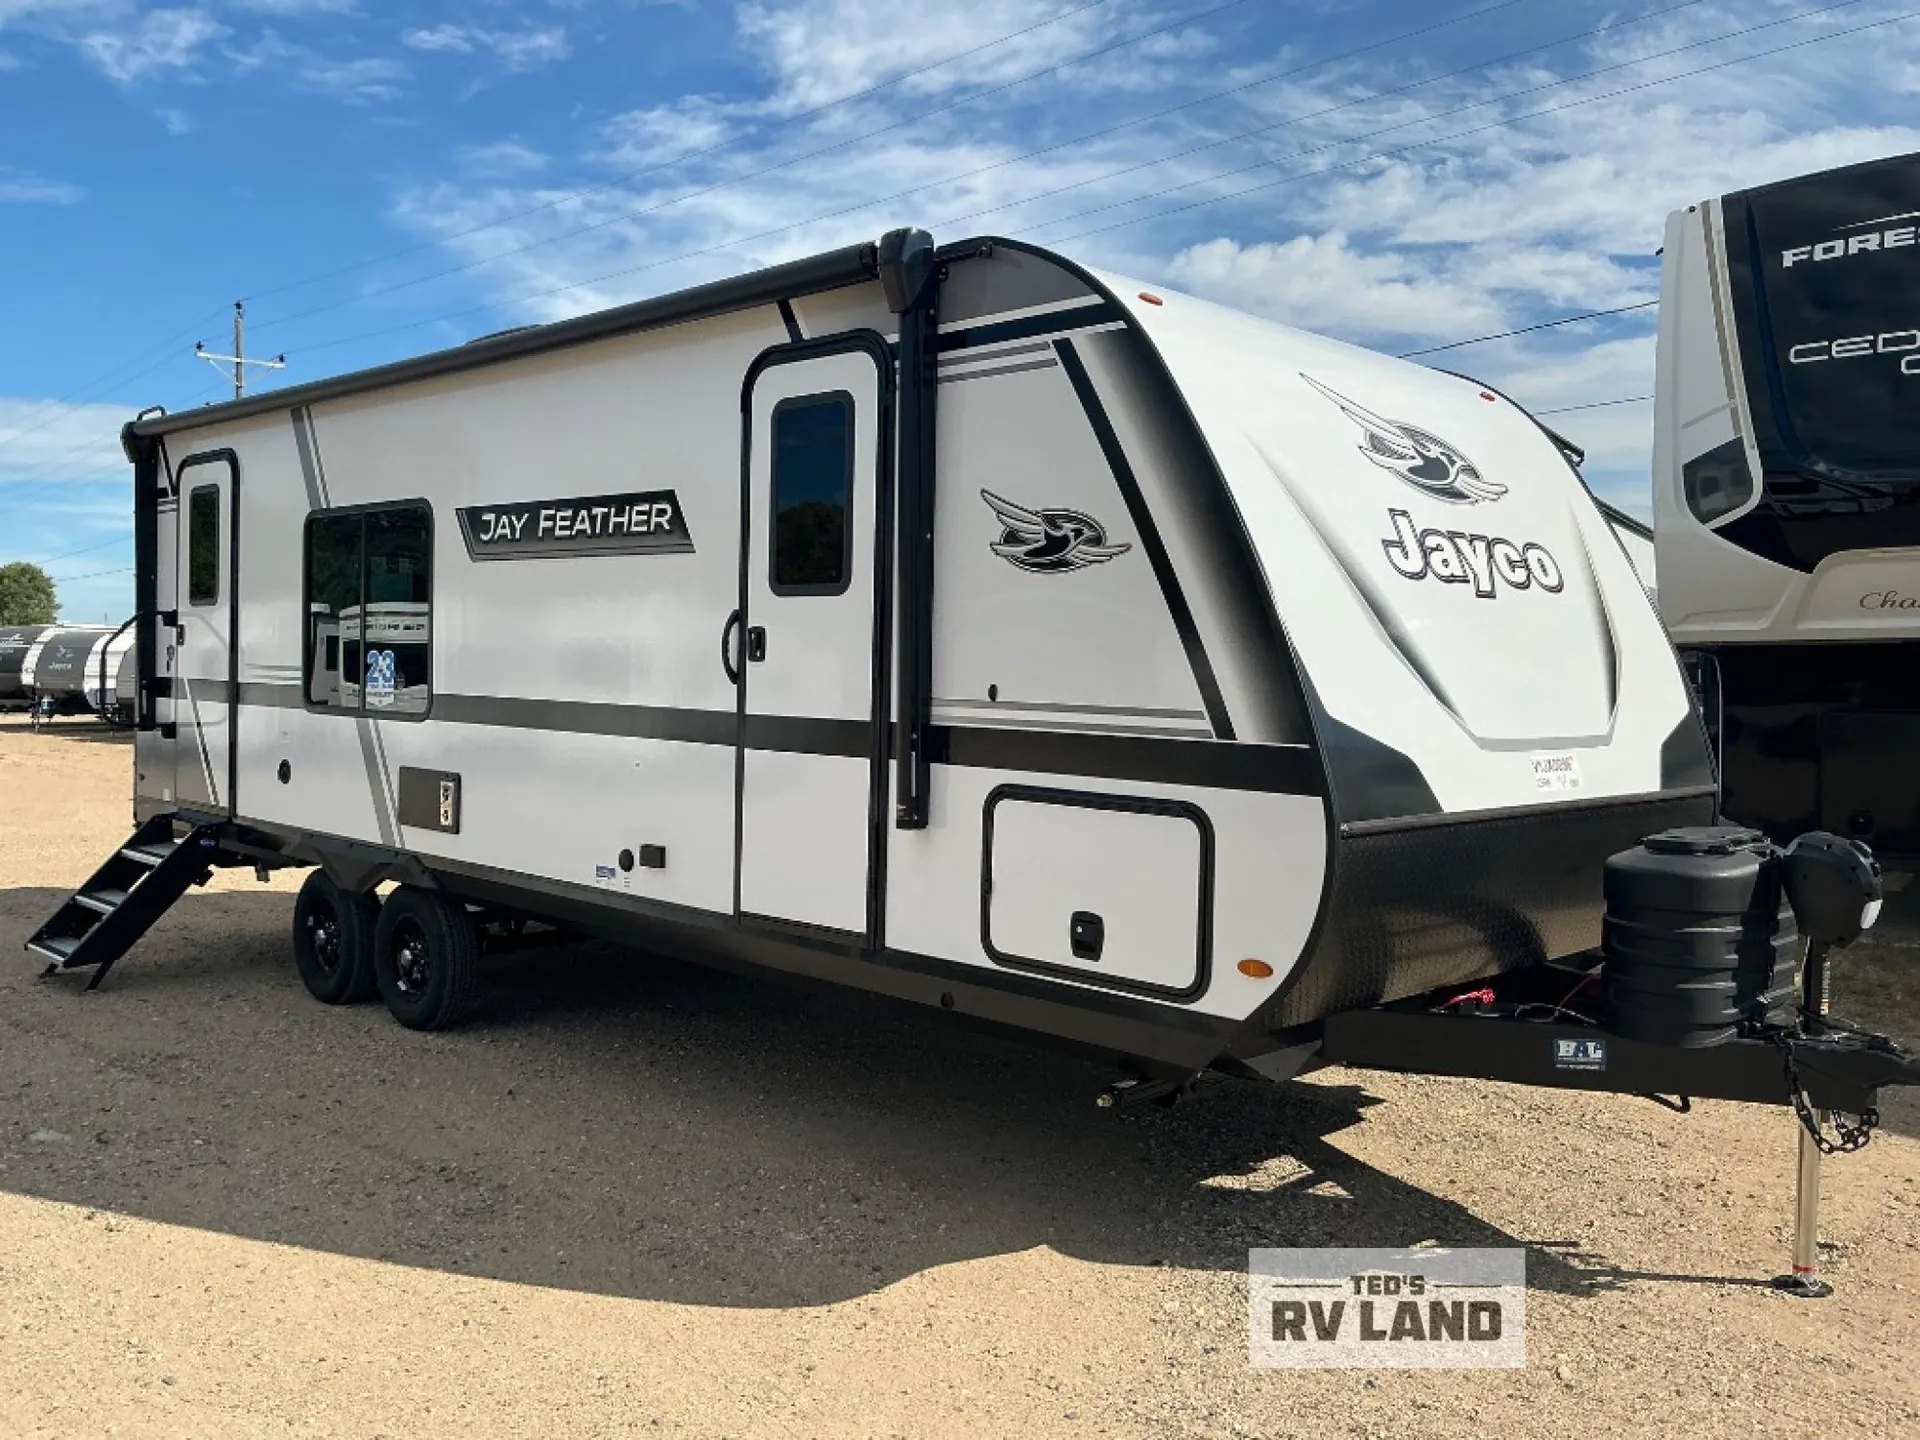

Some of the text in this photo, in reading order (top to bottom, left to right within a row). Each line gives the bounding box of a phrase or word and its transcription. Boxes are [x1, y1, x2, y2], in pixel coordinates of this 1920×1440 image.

[1781, 226, 1920, 268] FORE
[479, 503, 673, 542] JAY FEATHER
[1381, 508, 1564, 599] Jayco
